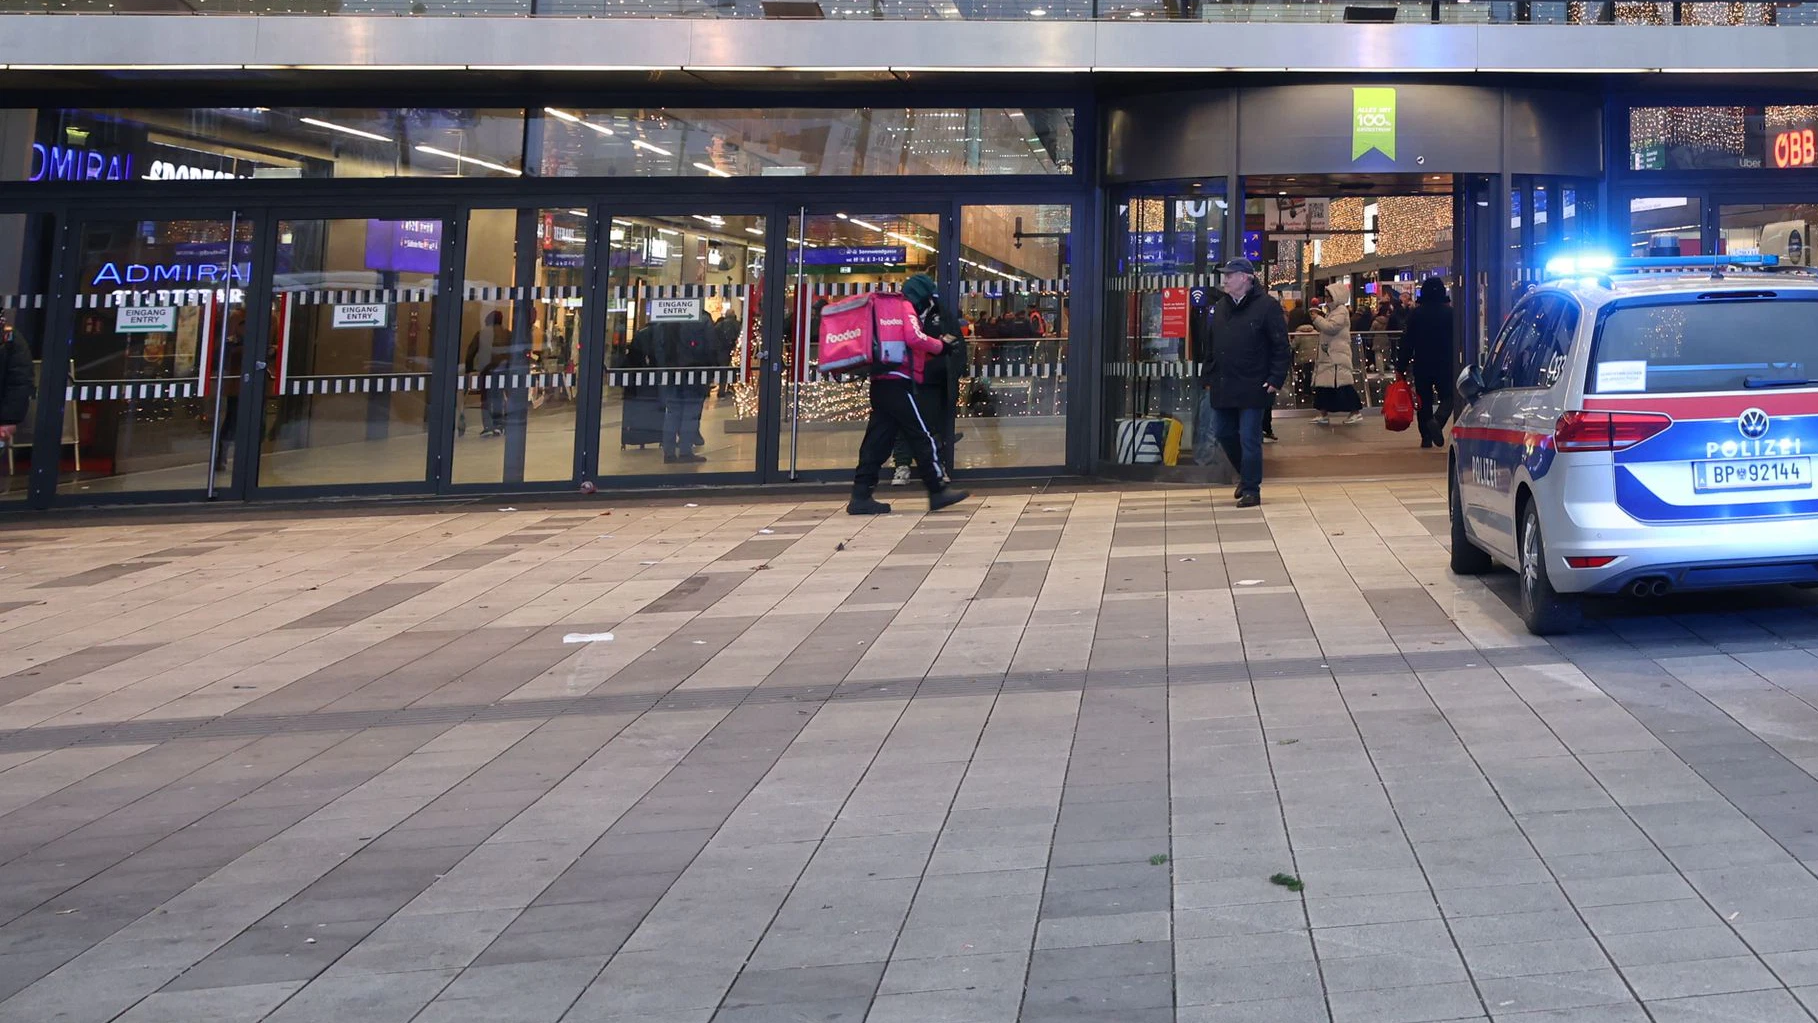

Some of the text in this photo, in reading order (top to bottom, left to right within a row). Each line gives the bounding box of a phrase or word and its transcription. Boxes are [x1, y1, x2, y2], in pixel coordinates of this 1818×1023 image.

[1774, 129, 1816, 168] ÖBB
[1739, 159, 1761, 168] Uber
[130, 316, 160, 324] ENTRY
[1706, 438, 1801, 458] POLIZEI
[1471, 455, 1498, 488] POLIZEI
[1714, 465, 1735, 483] BP
[1748, 462, 1800, 482] 92144
